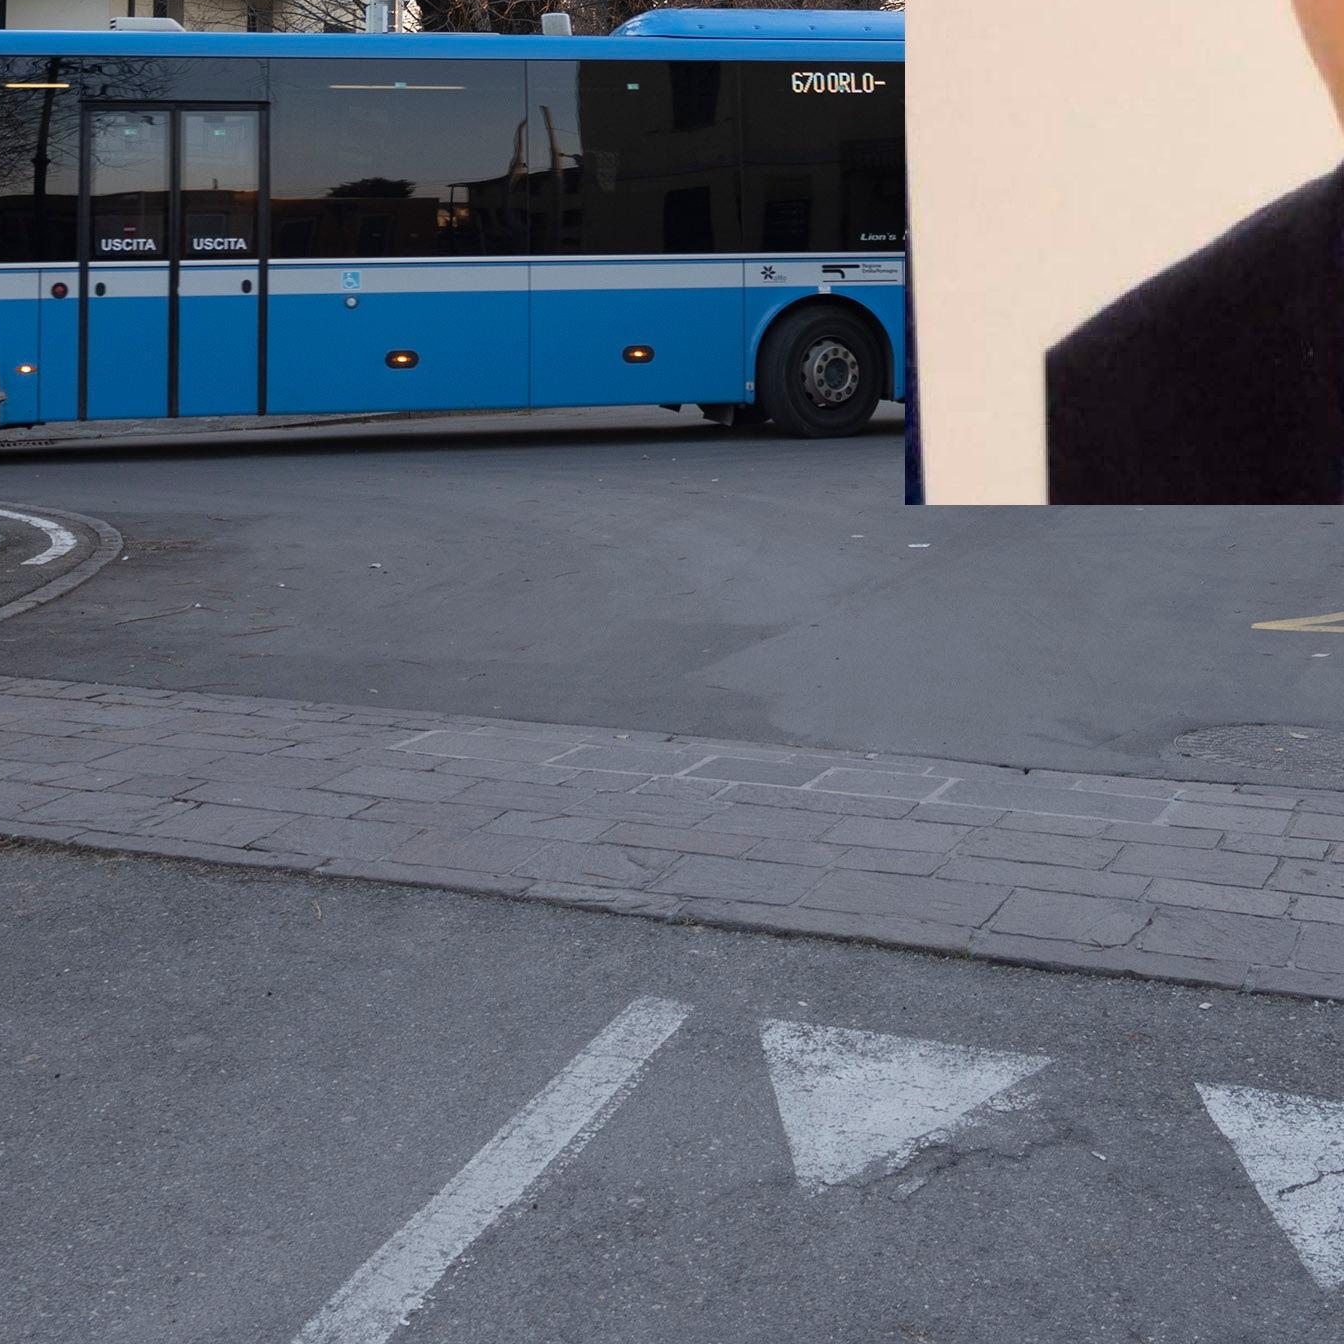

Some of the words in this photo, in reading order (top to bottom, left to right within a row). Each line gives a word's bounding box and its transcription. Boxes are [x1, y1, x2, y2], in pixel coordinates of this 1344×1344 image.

[791, 71, 825, 93] 670
[860, 232, 897, 241] Lion's
[101, 238, 156, 251] USCITA
[193, 237, 247, 250] USCITA
